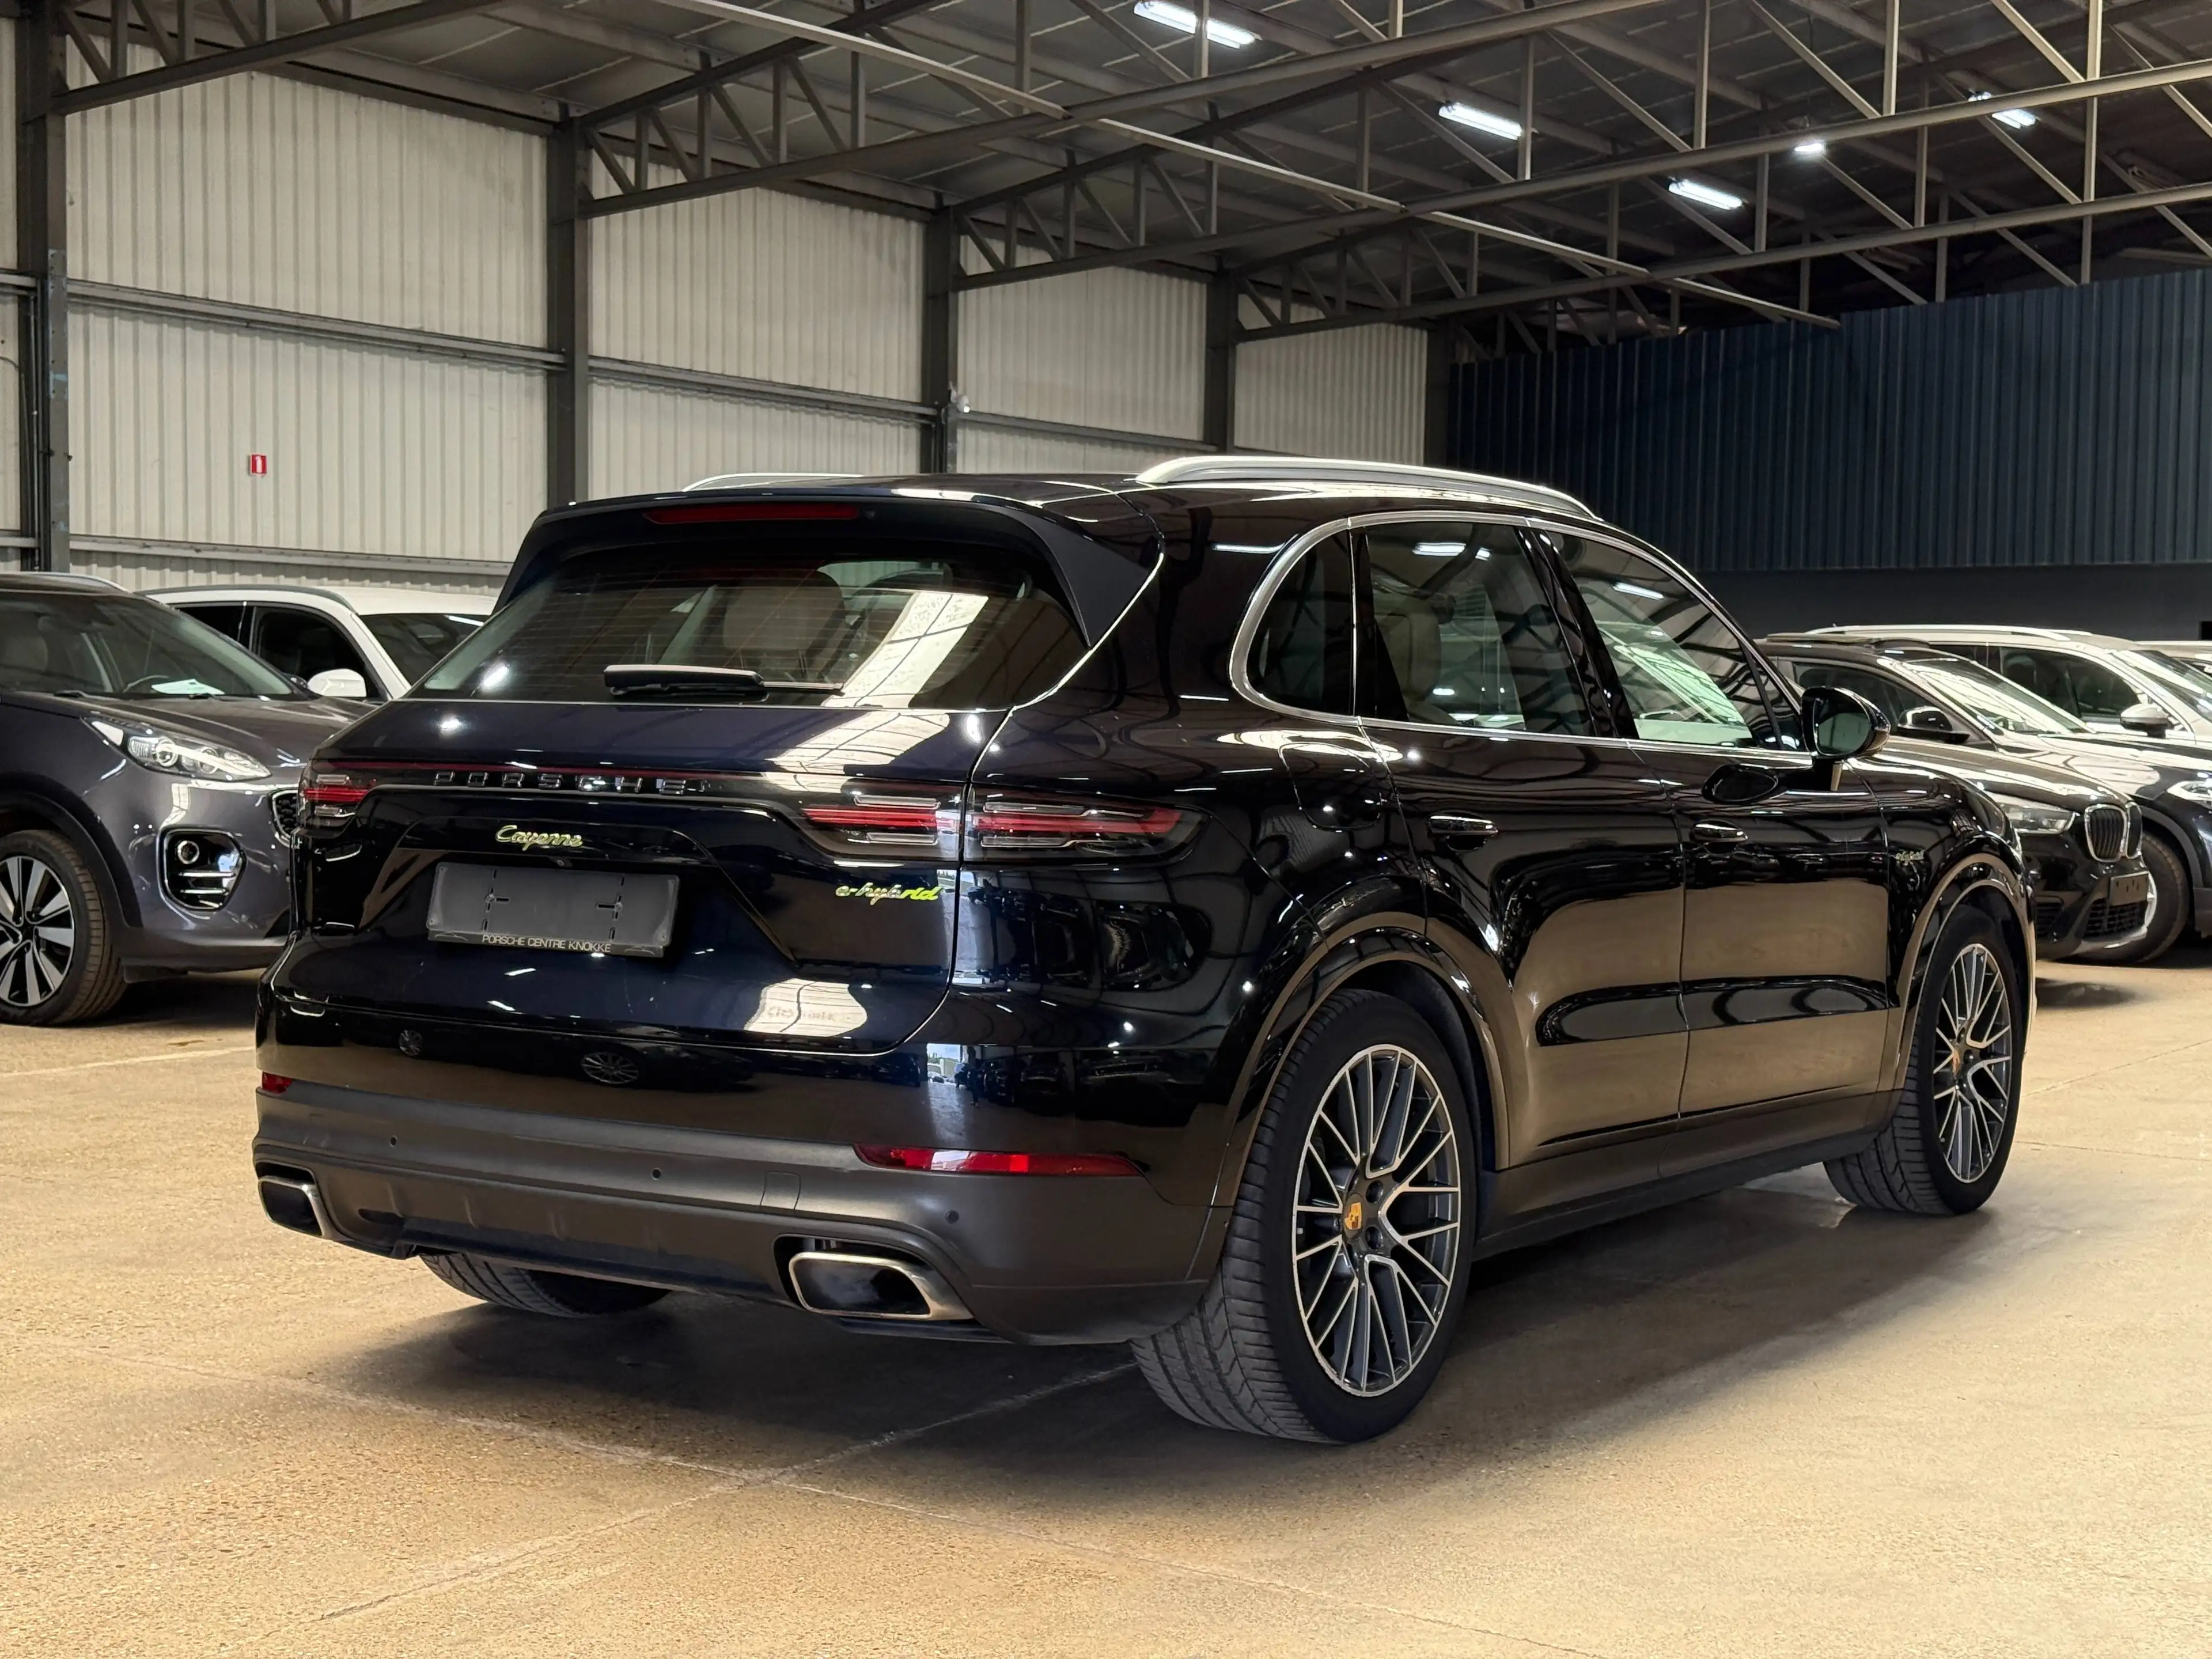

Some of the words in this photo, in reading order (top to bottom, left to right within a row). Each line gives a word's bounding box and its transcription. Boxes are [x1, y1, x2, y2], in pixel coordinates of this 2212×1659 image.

[434, 771, 687, 796] PORSCHE
[495, 825, 583, 851] Cayenne
[836, 882, 942, 906] e-hybrid
[482, 934, 525, 946] PORSCHE
[528, 937, 566, 949] CENTRE
[569, 940, 611, 952] KNOKKE
